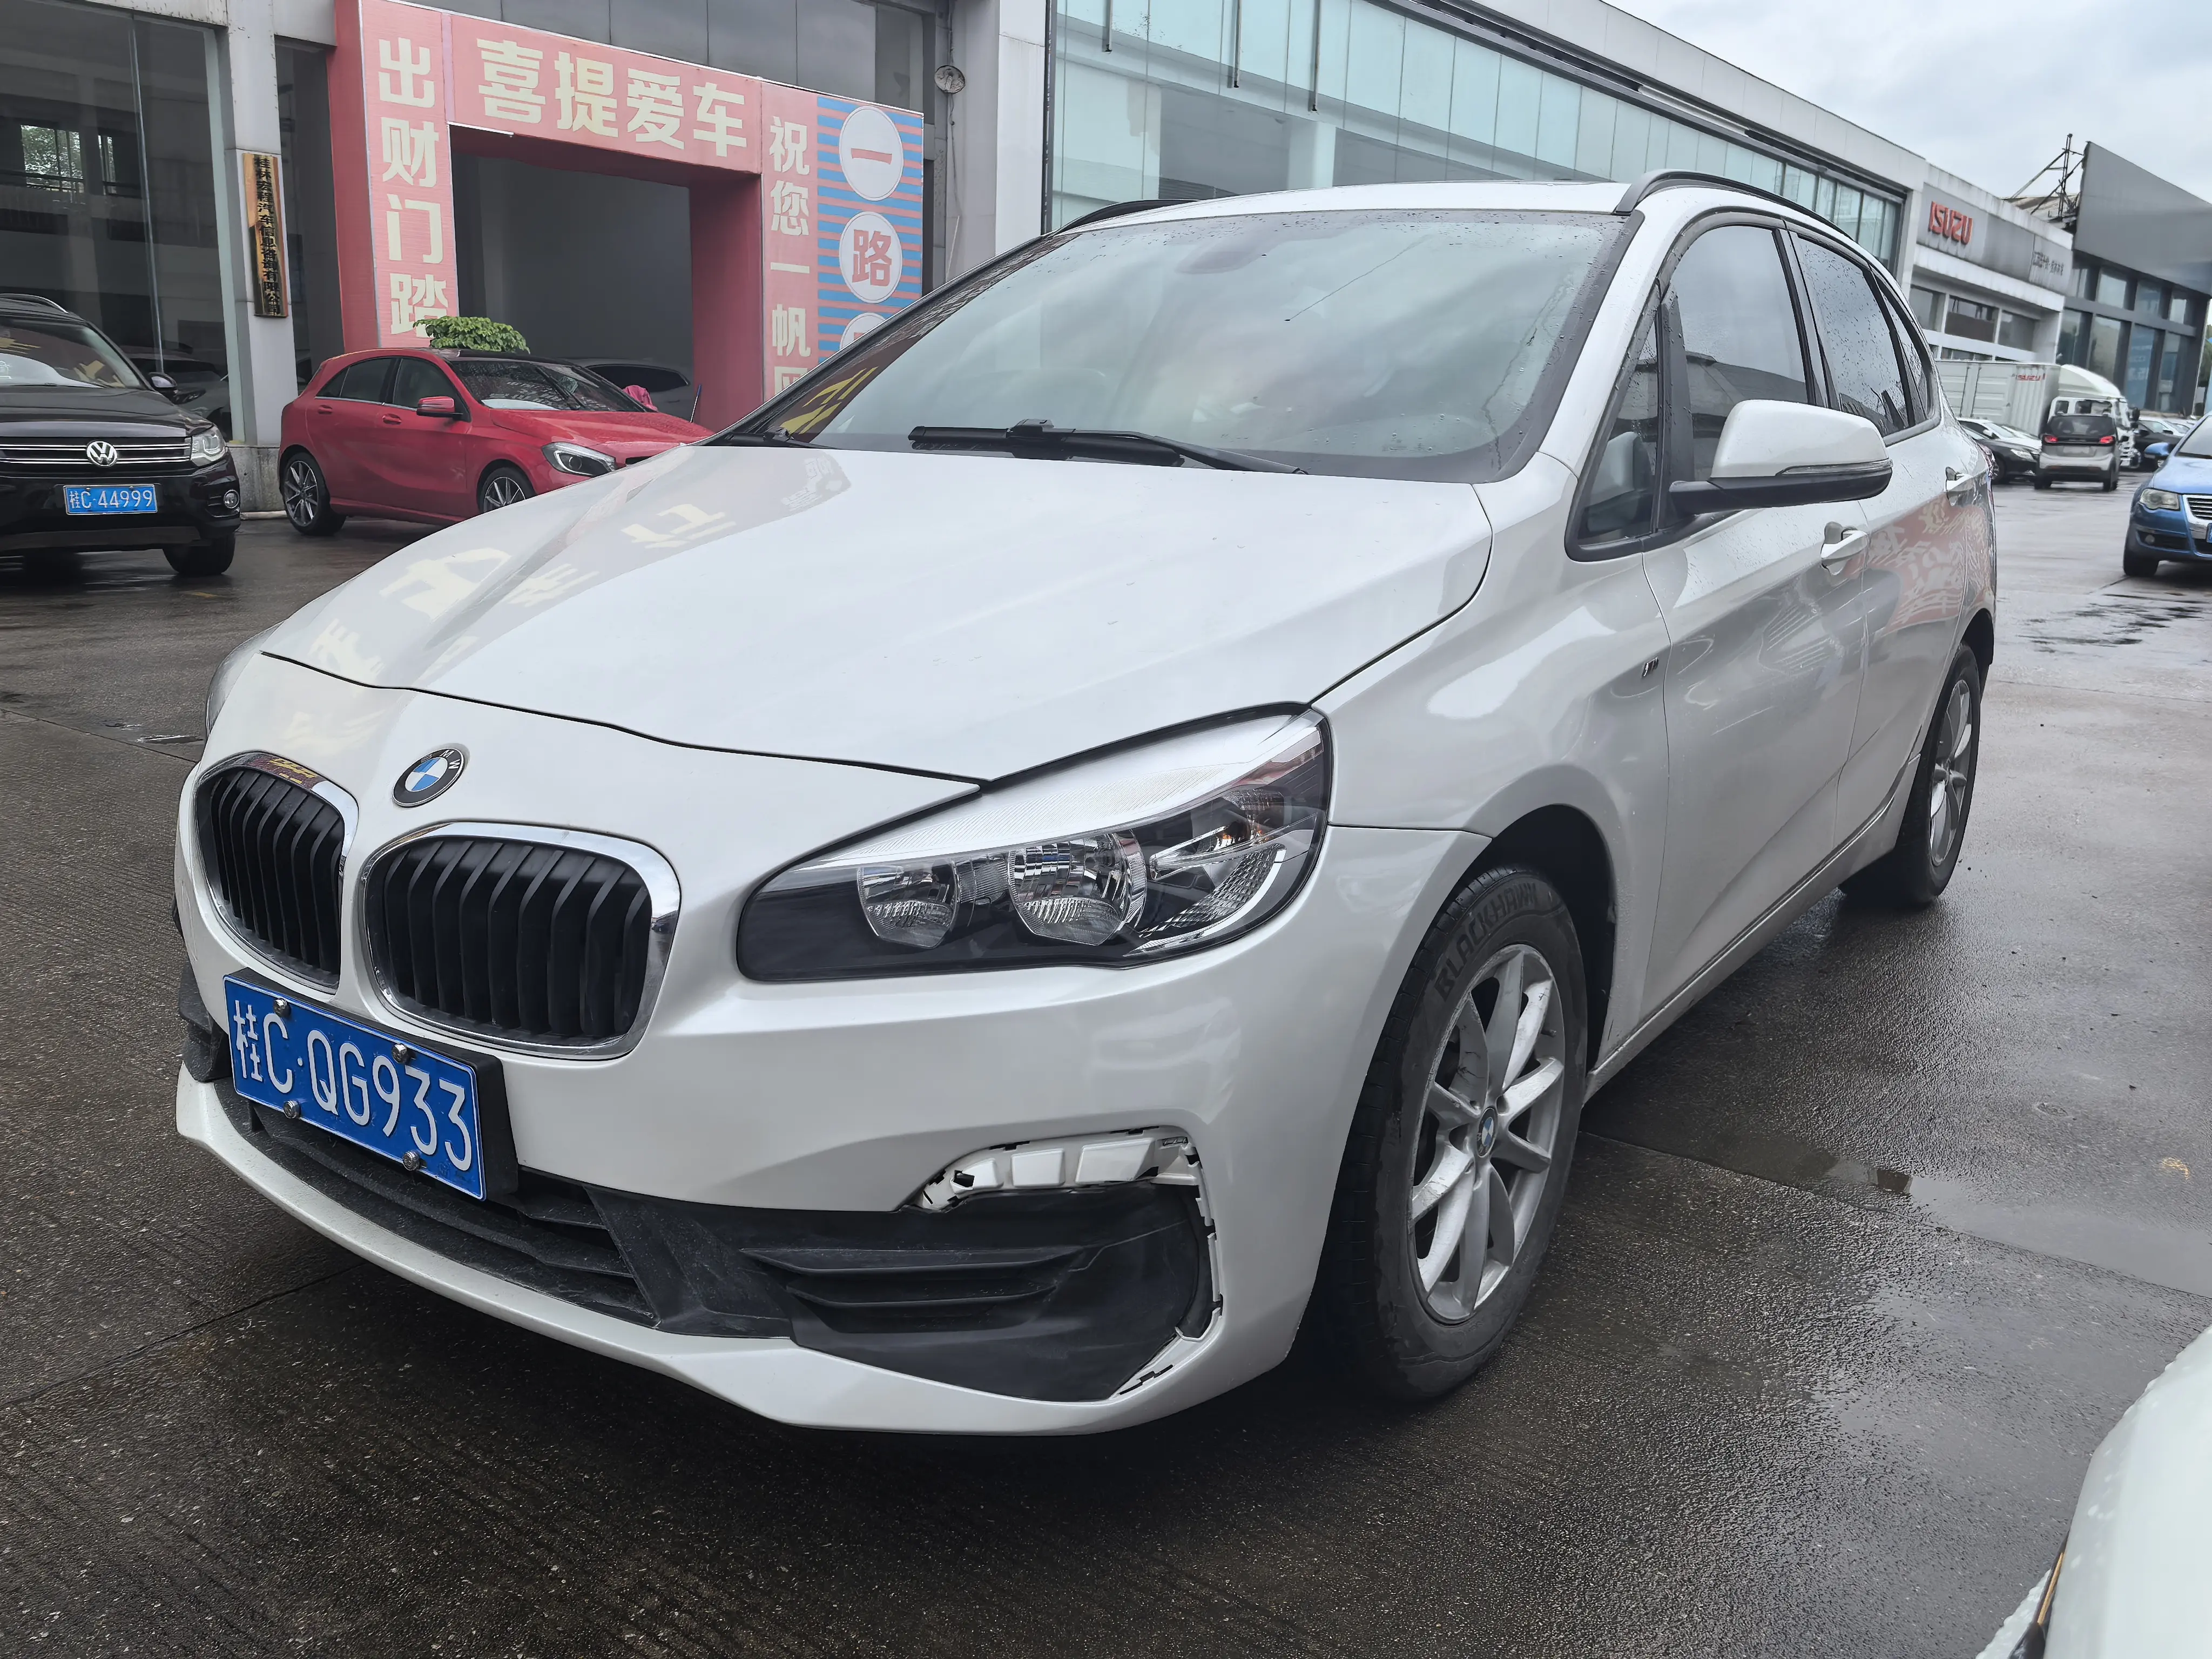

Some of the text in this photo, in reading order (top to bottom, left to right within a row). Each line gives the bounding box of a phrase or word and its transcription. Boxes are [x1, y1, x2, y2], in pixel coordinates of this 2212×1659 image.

[476, 39, 747, 158] 喜提爱车
[378, 37, 449, 338] 出财门踏
[1928, 201, 1973, 245] ISUZU
